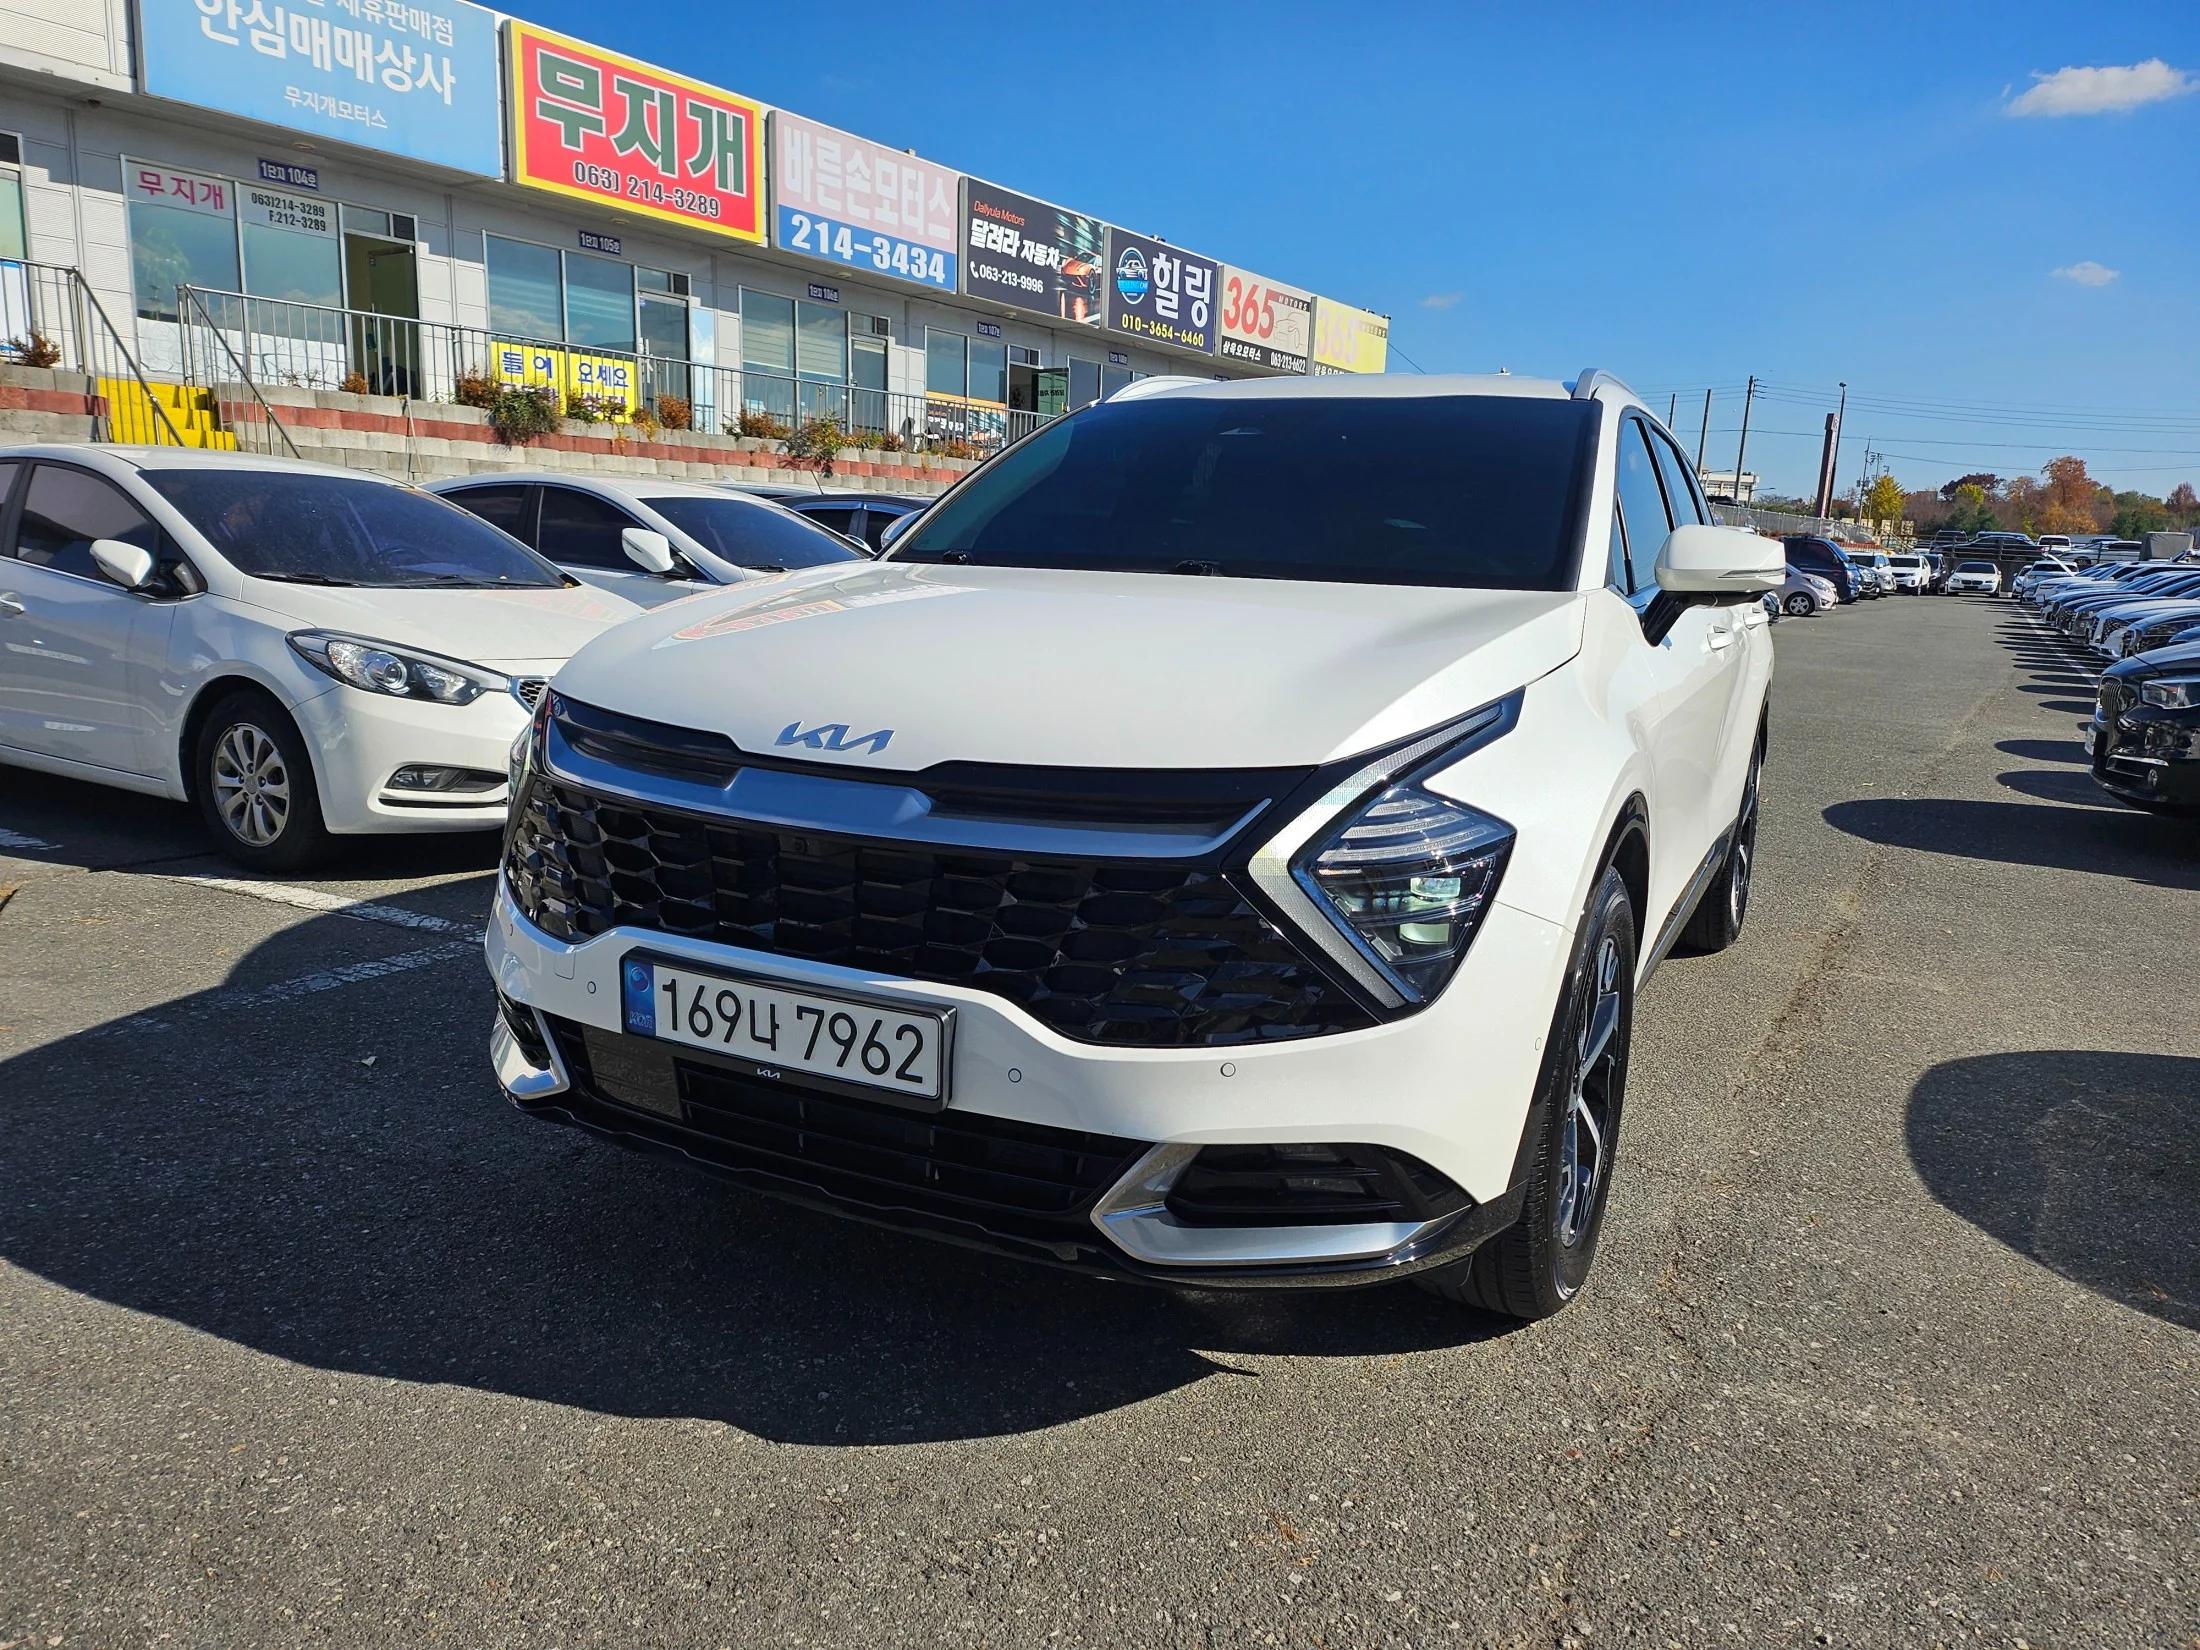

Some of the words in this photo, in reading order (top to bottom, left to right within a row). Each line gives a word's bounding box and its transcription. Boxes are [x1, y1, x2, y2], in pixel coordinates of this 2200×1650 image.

[194, 0, 456, 105] 안심매매상사
[283, 85, 388, 129] 무지개모터스
[536, 48, 747, 196] 무지개
[137, 170, 225, 210] 무지개
[287, 169, 317, 188] 104호
[574, 160, 621, 193] 063)
[627, 175, 721, 219] 214-3289
[784, 124, 951, 241] 바른손모터스
[251, 192, 325, 218] 063)214-3289
[1001, 209, 1025, 226] Motors
[791, 213, 946, 284] 214-3434
[969, 217, 1020, 258] 달려라
[1020, 239, 1060, 270] 자동차
[979, 264, 1044, 294] 063-213-9996
[1152, 252, 1212, 328] 힐링
[1223, 276, 1275, 339] 365
[1278, 295, 1309, 312] MOTORS
[1121, 313, 1205, 348] 010-3654-6460
